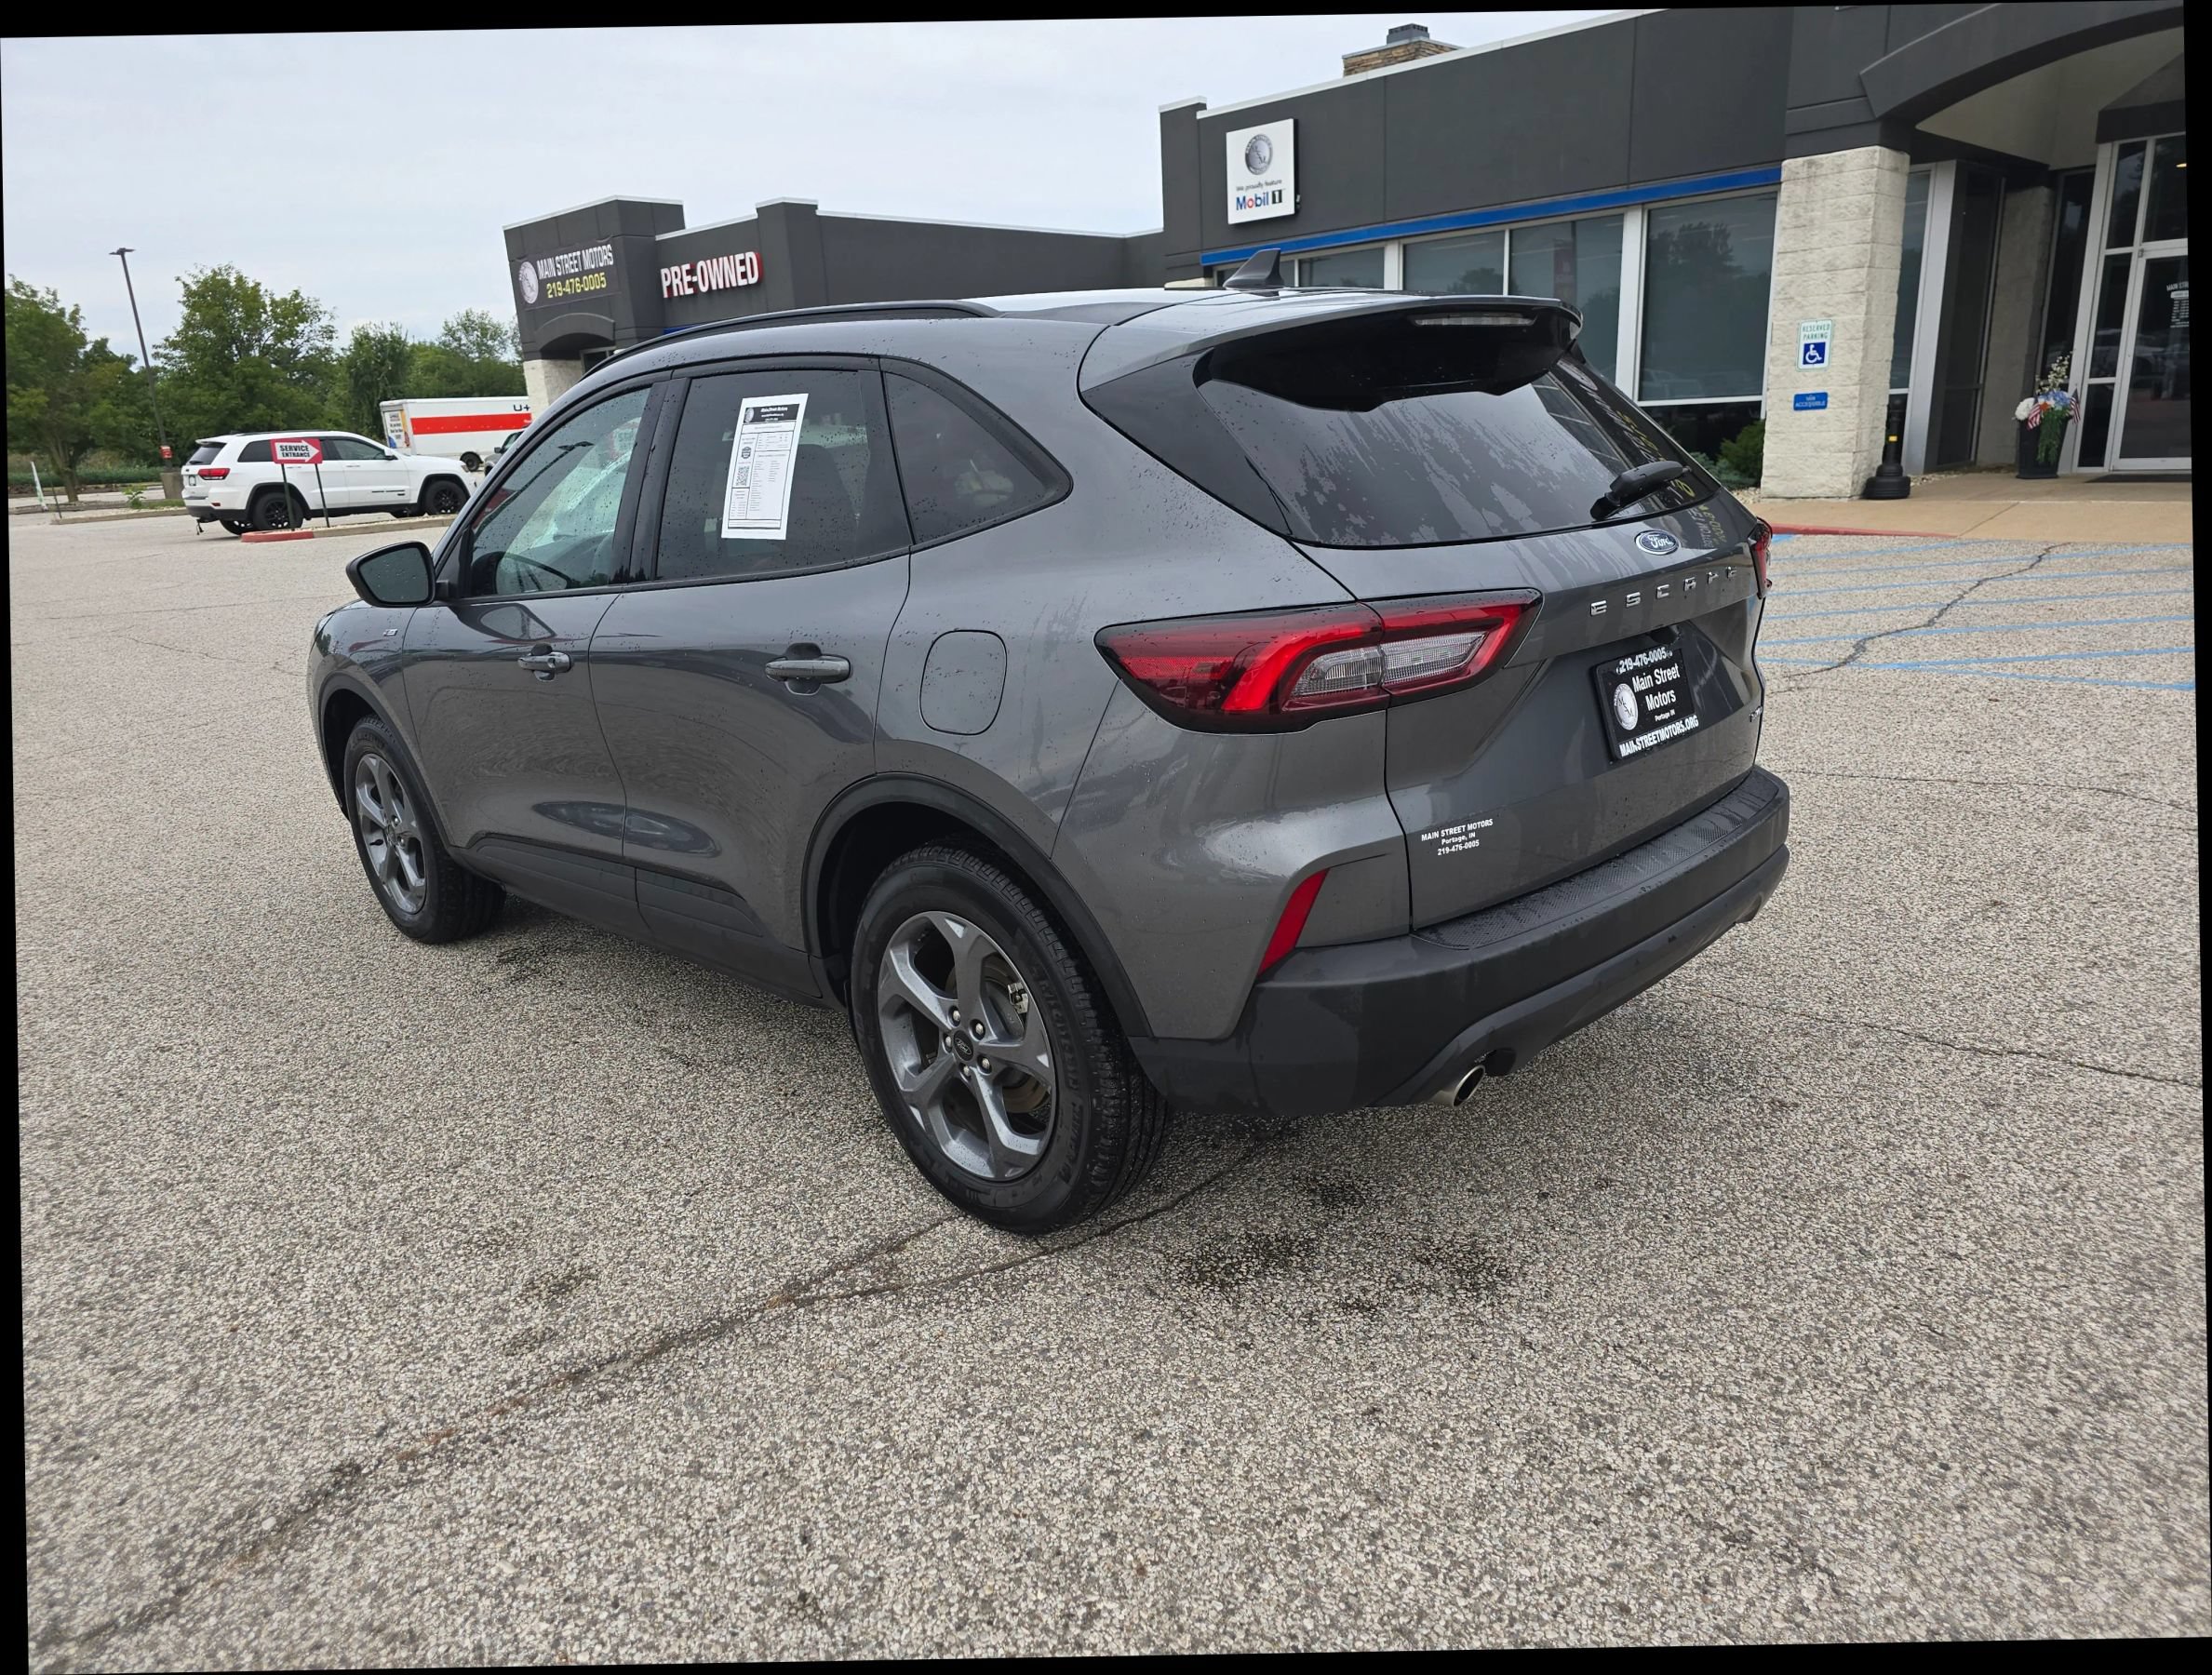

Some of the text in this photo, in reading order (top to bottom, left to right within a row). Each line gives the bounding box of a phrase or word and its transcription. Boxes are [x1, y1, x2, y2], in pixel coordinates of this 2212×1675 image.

[1236, 189, 1282, 210] Mobil 1
[537, 244, 613, 280] MAIN STREET MOTORS
[546, 272, 607, 299] 219-476-0005
[660, 250, 760, 298] PRE-OWNED
[1803, 323, 1830, 332] RESERVED
[1647, 534, 1674, 549] Ford
[1590, 565, 1737, 616] ESCAPE
[1619, 646, 1667, 674] 219-476-0005
[1631, 663, 1680, 693] Main Street
[1644, 690, 1676, 712] Motors
[1421, 818, 1494, 841] MAIN STREET MOTORS
[1441, 835, 1468, 845] Portage,
[1438, 839, 1480, 856] 219-476-0005
